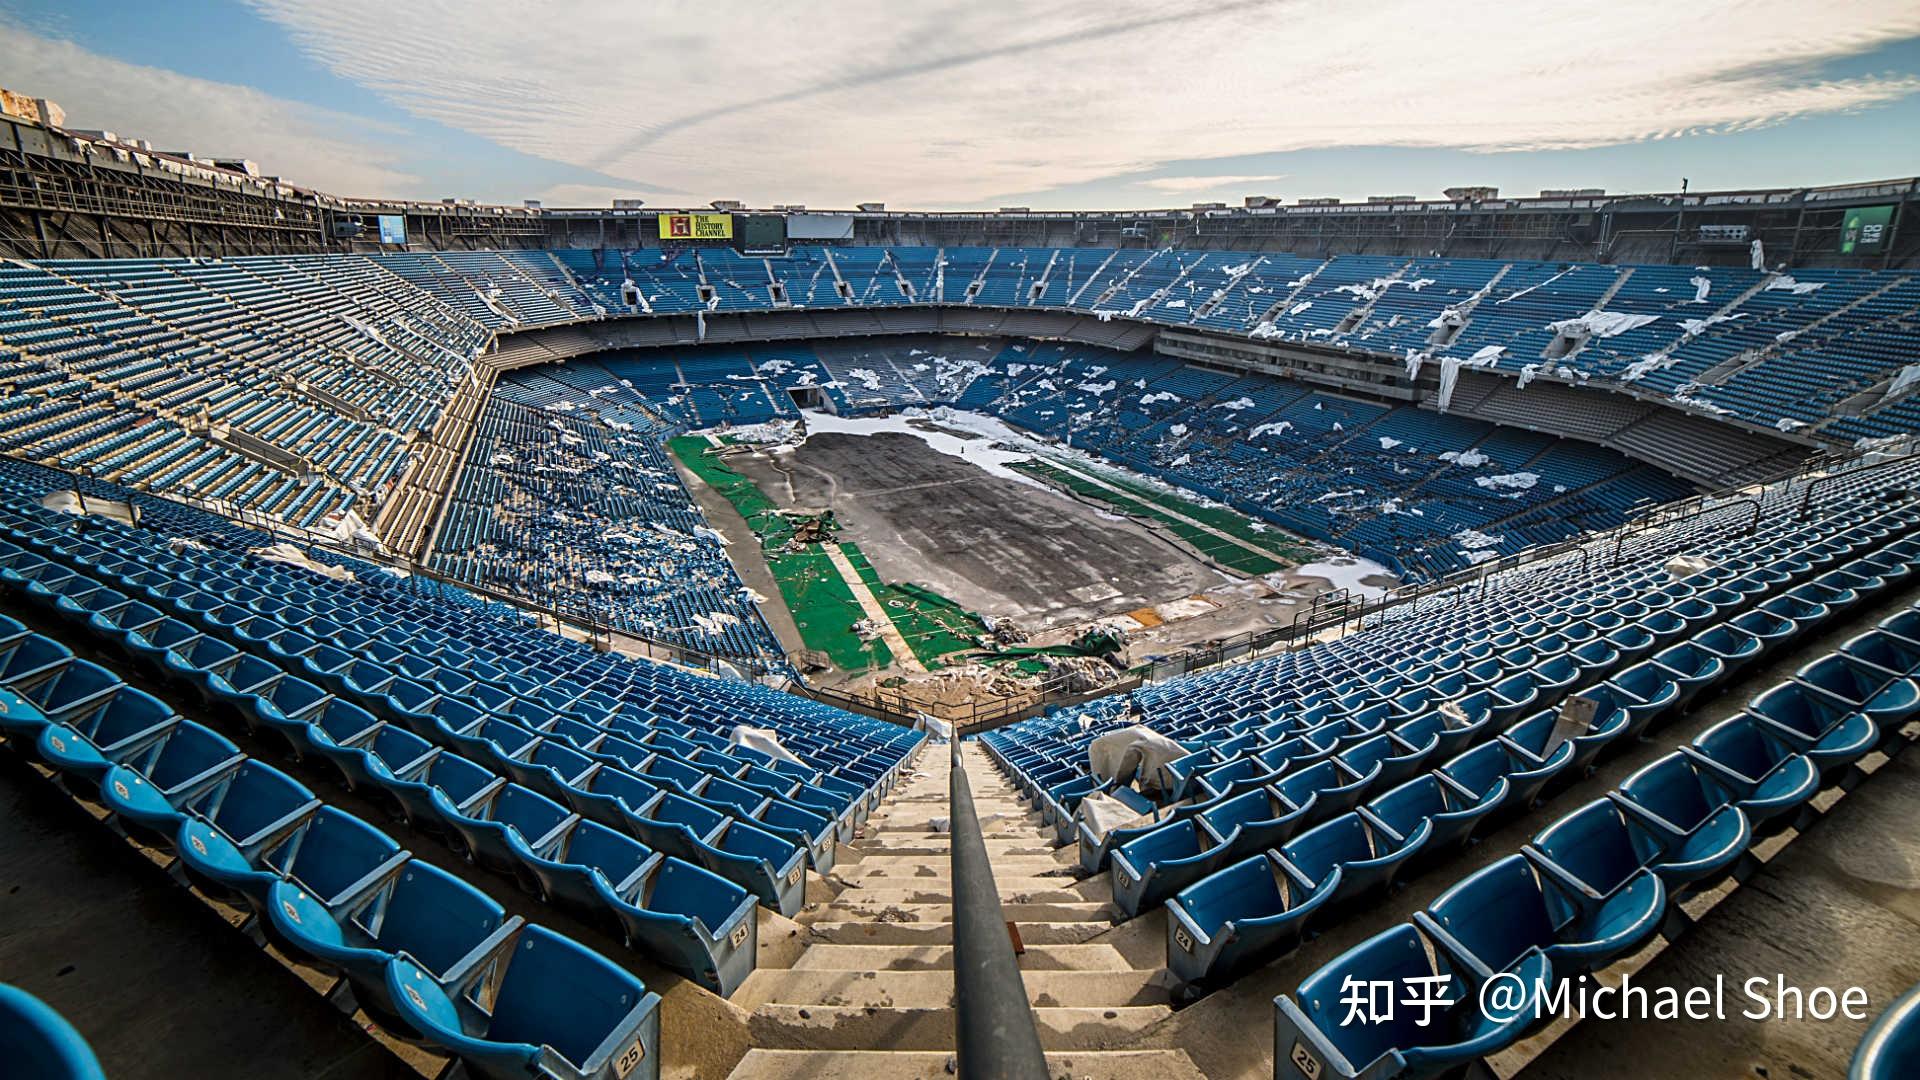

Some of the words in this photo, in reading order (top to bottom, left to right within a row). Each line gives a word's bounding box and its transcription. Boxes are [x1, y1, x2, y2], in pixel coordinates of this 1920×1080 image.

[695, 215, 709, 223] THE
[695, 222, 723, 230] HISTORY
[735, 930, 746, 944] 24
[1178, 932, 1188, 946] 24
[621, 1046, 638, 1072] 25
[1297, 1050, 1315, 1073] 25
